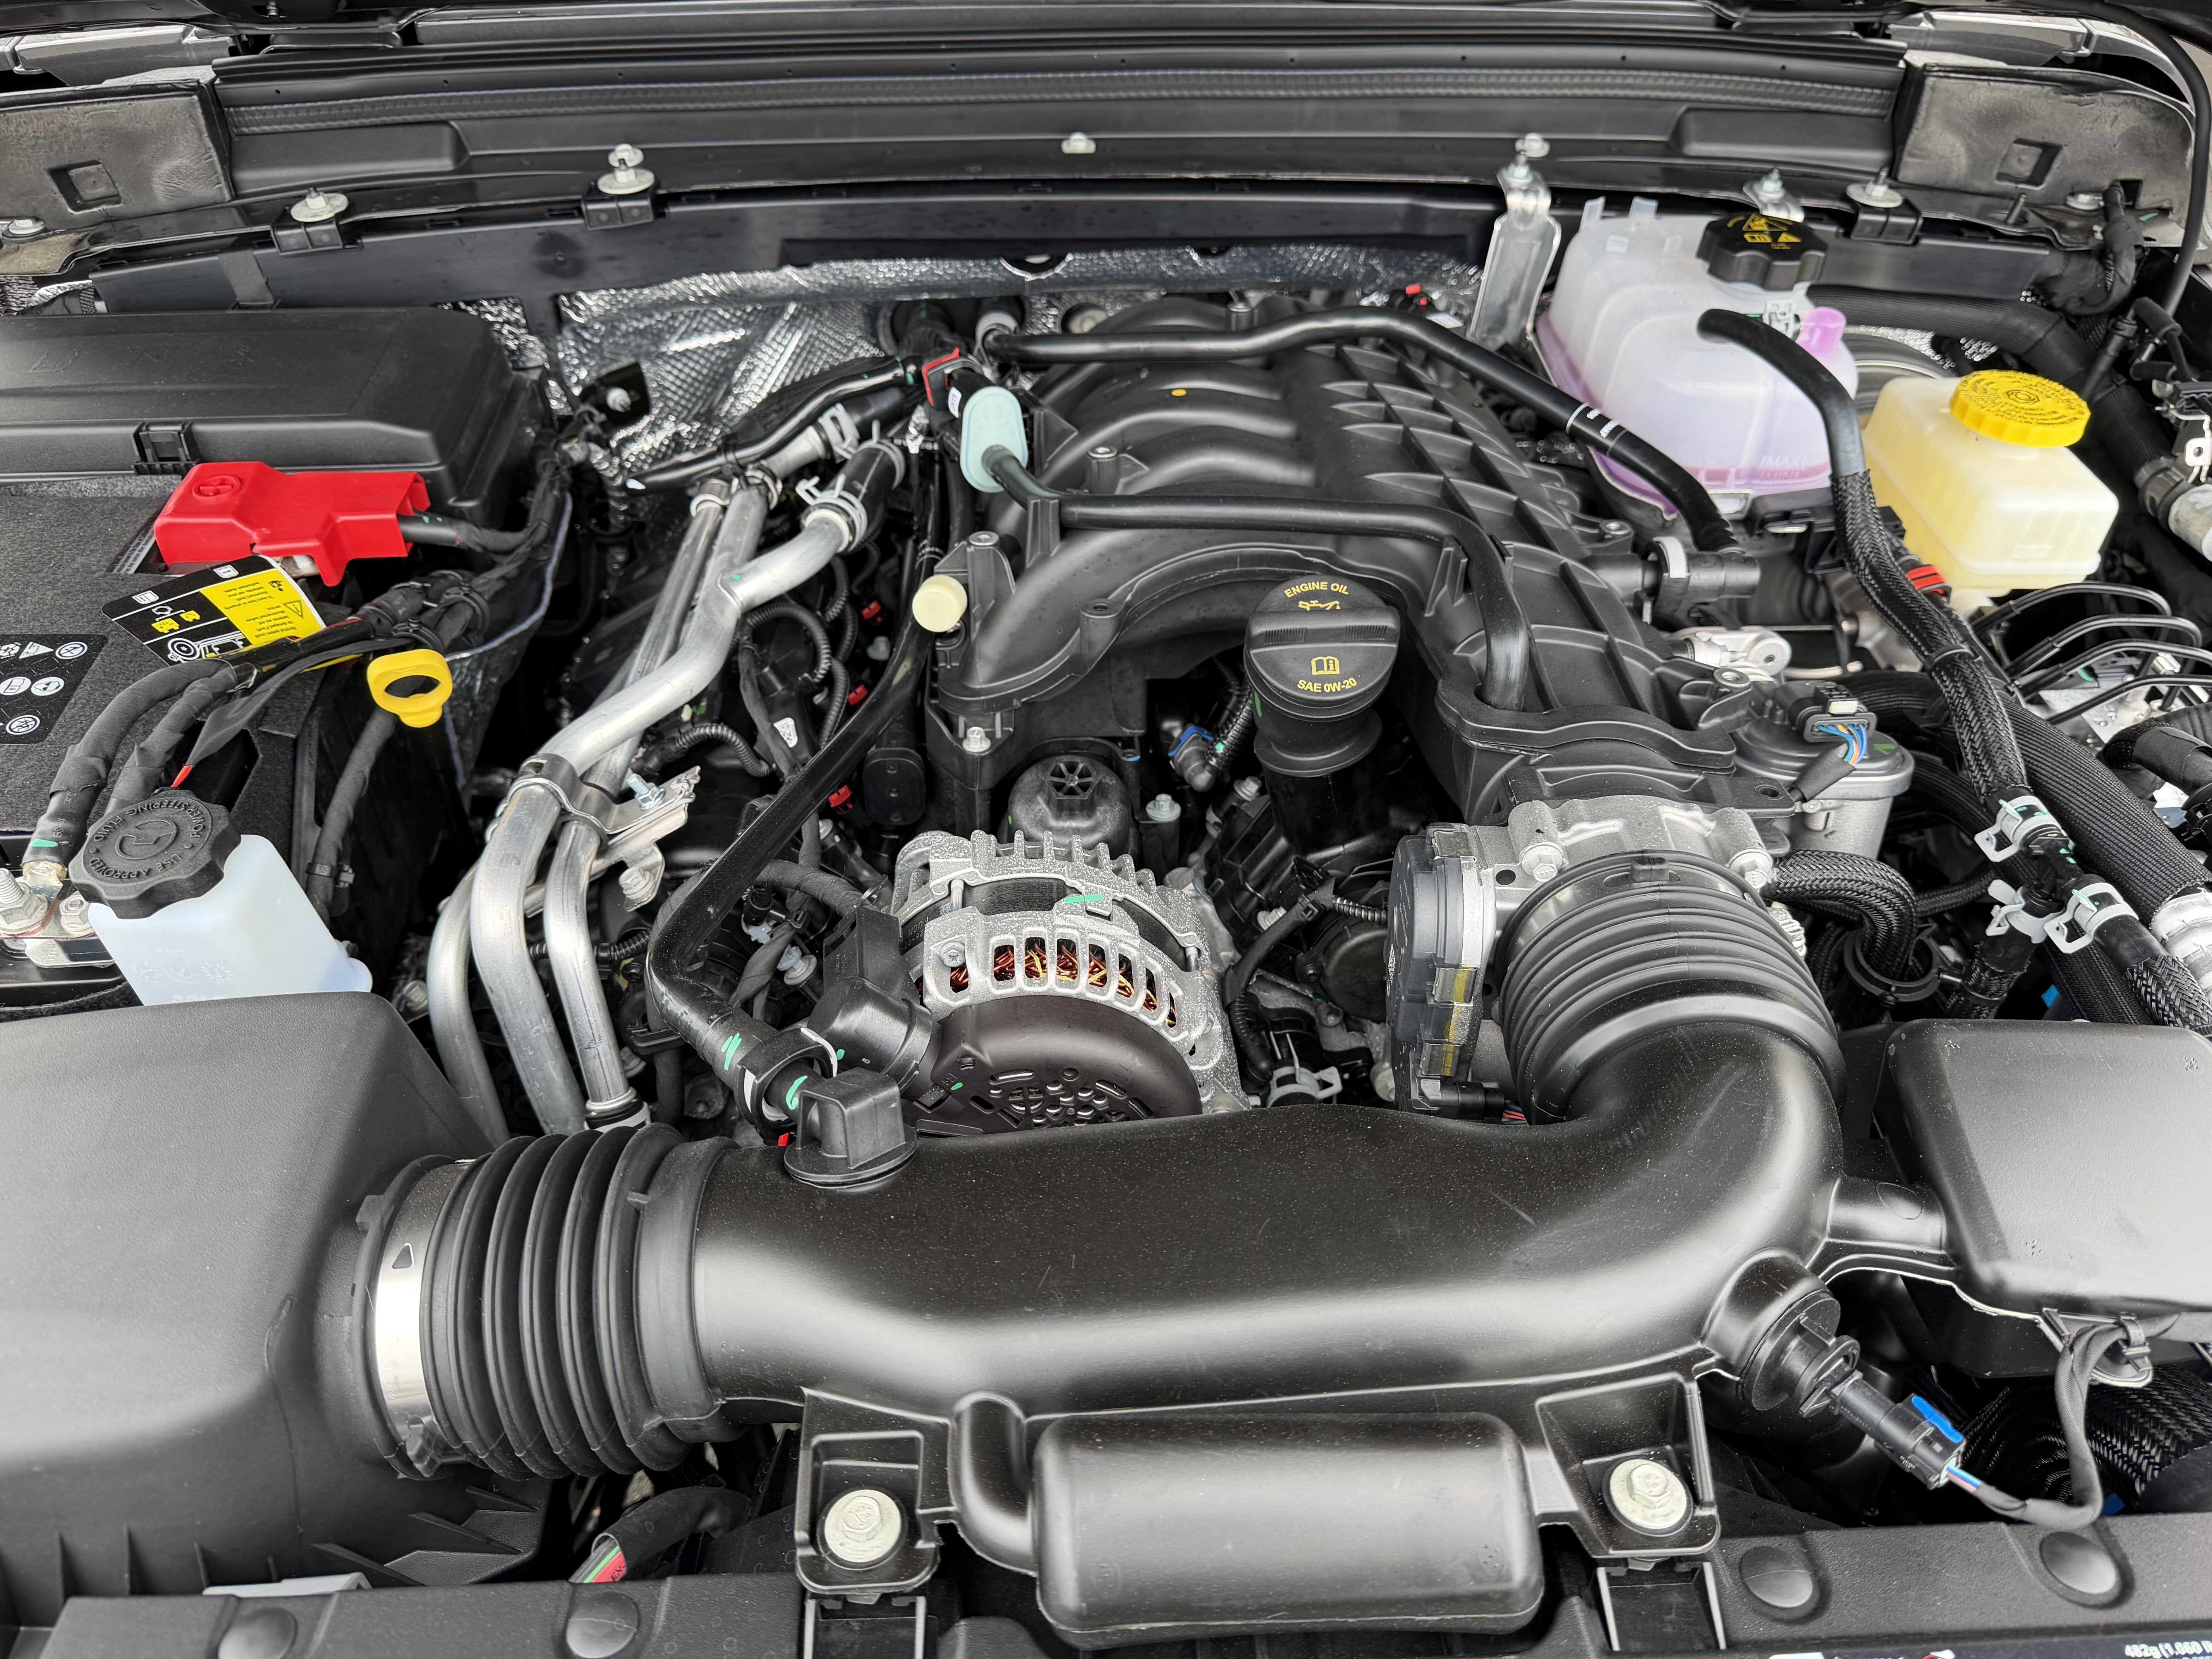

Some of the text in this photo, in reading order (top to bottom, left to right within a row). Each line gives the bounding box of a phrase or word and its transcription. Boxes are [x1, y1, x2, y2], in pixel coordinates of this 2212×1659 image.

[1284, 582, 1349, 598] ENGINE OIL
[1297, 678, 1357, 692] SAE 0W-20
[94, 800, 204, 841] POWER STEERING FLUID
[90, 854, 182, 879] USE APPROVED
